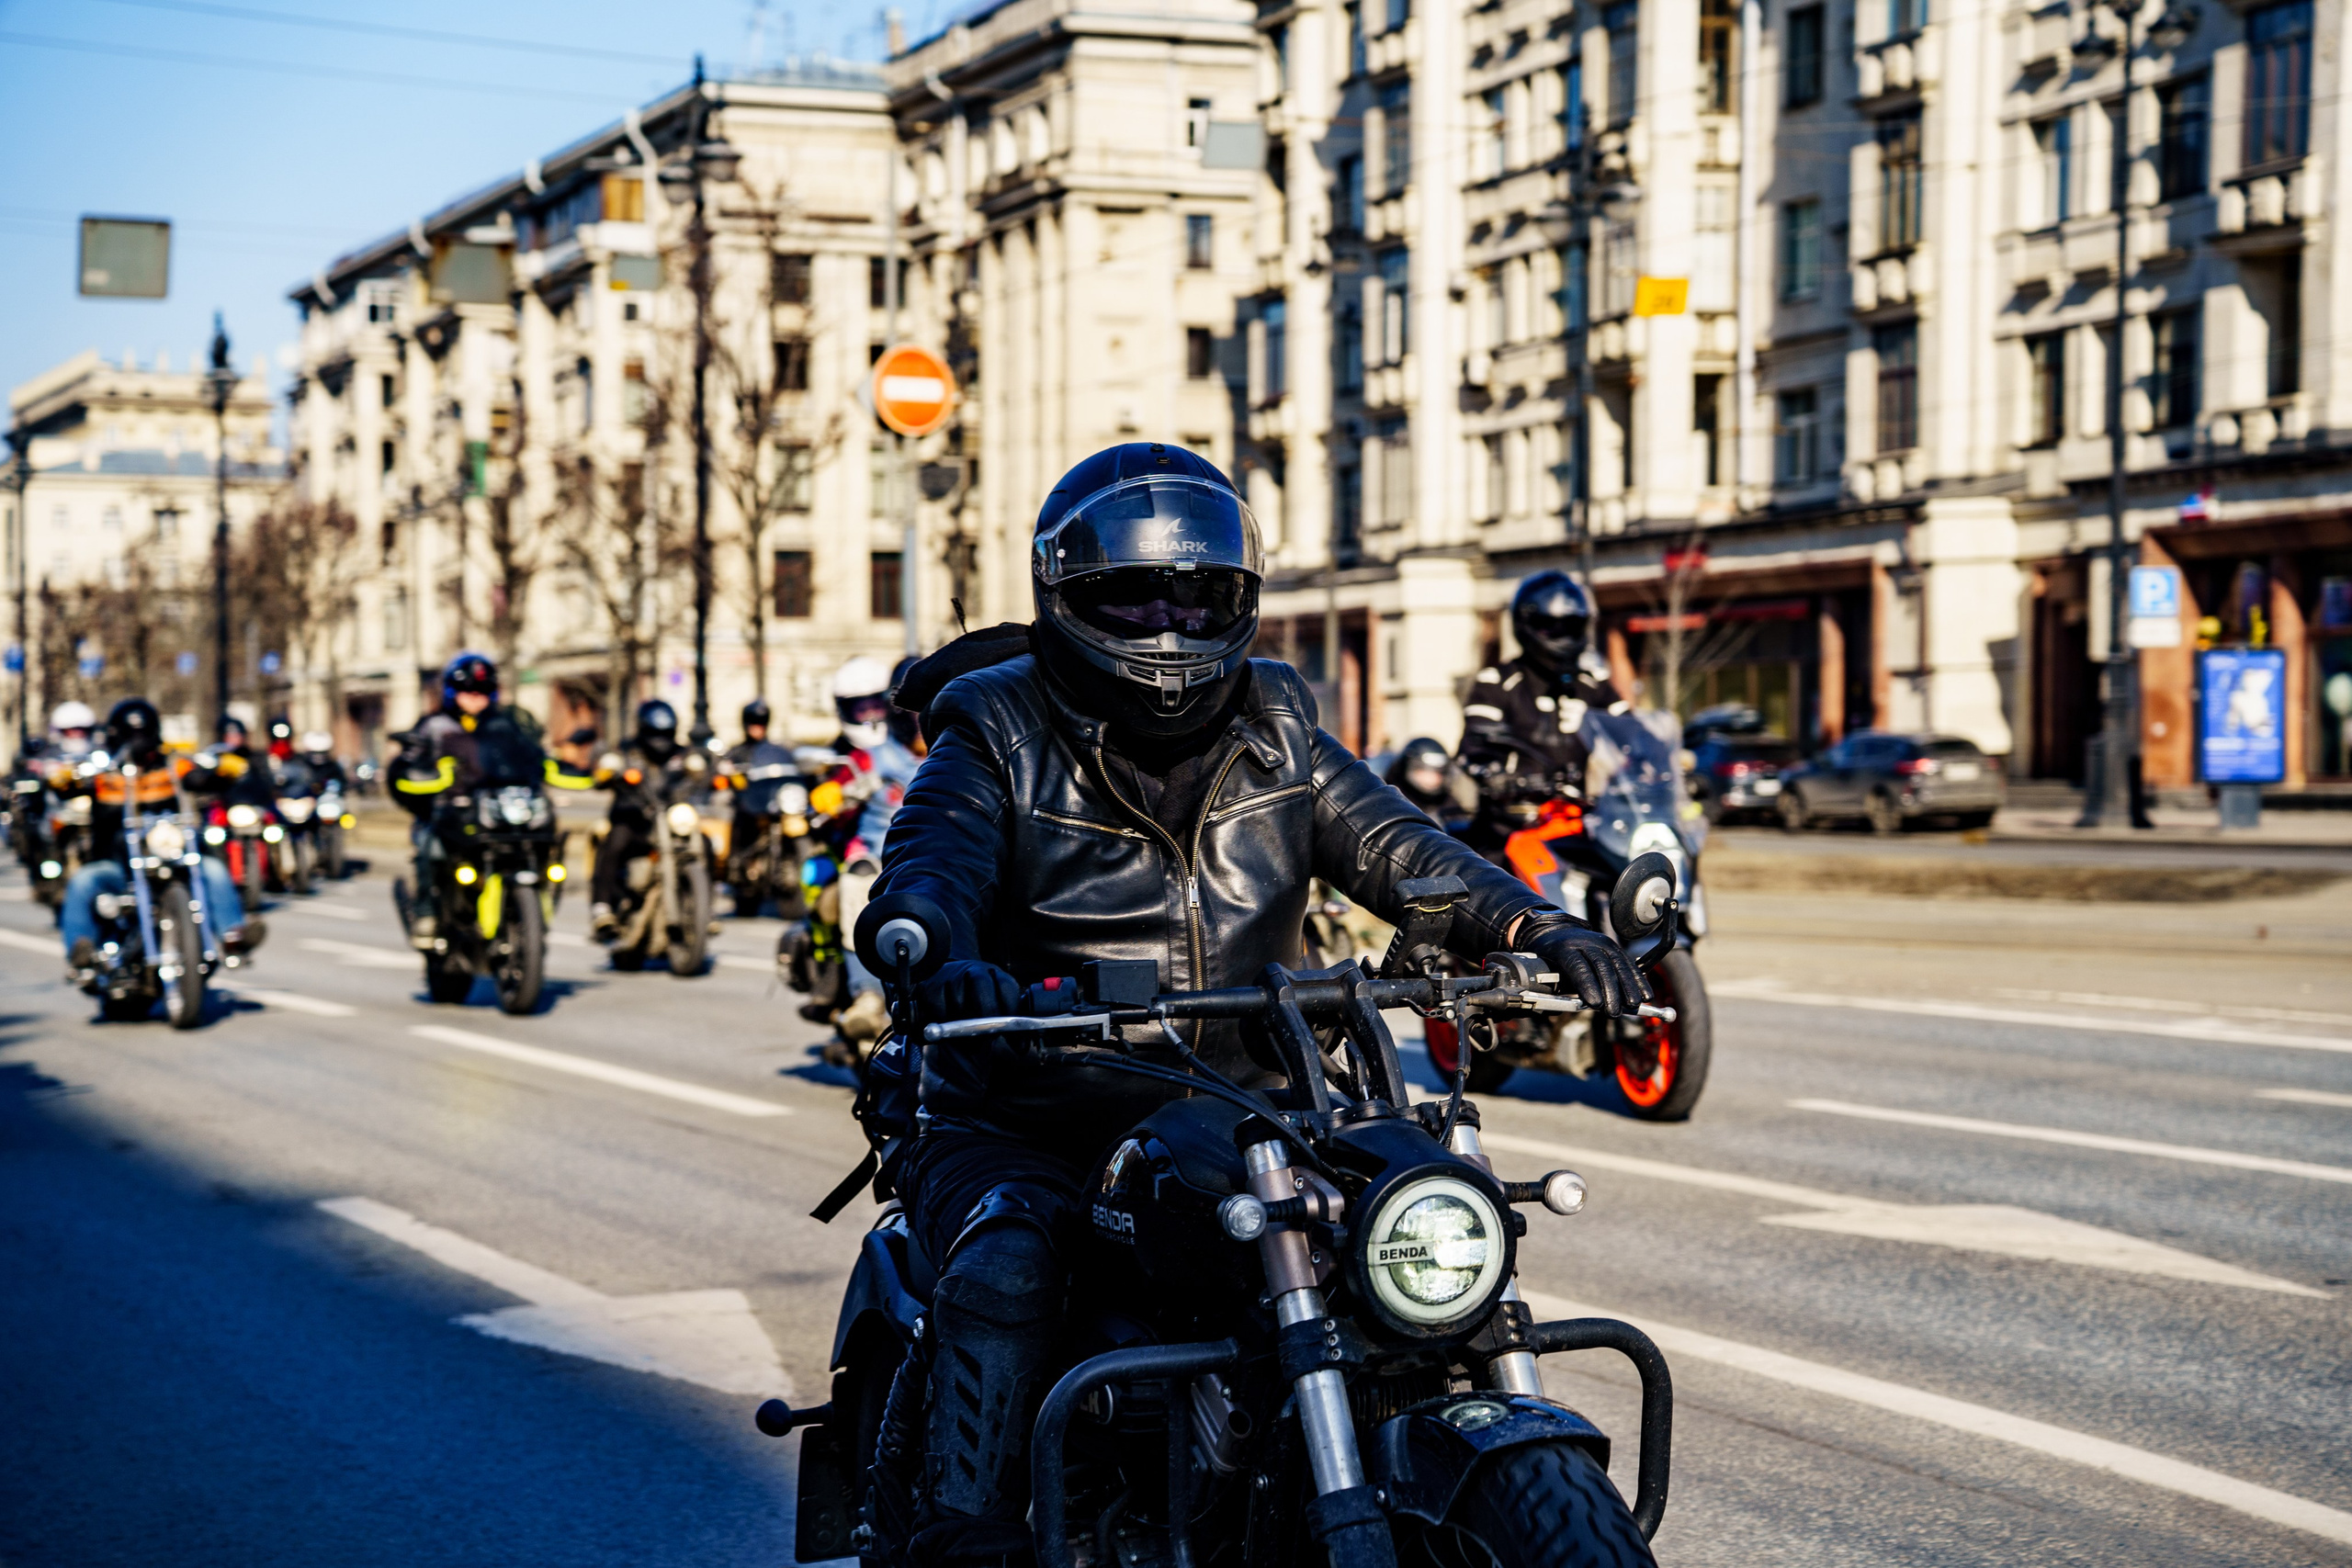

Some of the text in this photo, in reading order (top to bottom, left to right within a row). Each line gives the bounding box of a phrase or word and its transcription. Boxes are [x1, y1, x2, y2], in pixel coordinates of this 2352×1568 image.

[1138, 540, 1208, 553] SHARK
[2140, 570, 2168, 612] P
[1093, 1203, 1135, 1234] BENDA
[1095, 1228, 1136, 1245] TORCYCLE
[1379, 1246, 1428, 1260] BENDA
